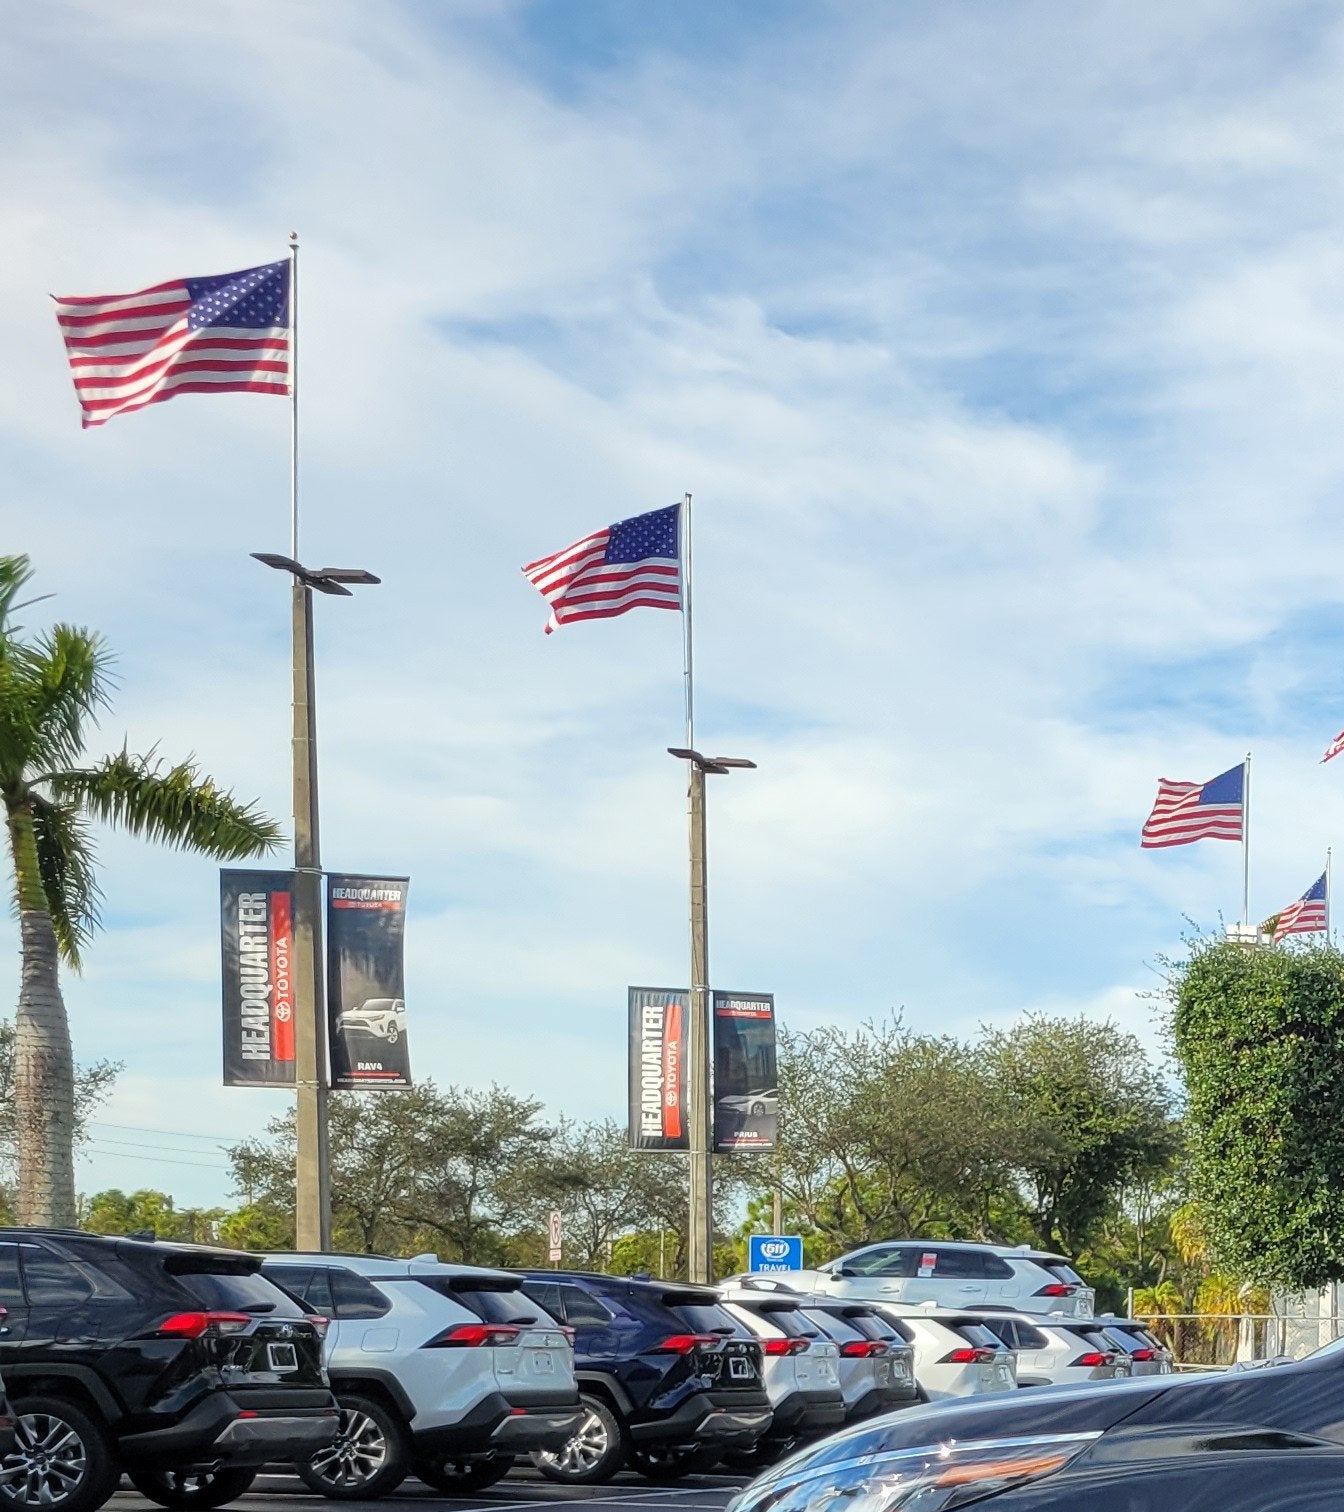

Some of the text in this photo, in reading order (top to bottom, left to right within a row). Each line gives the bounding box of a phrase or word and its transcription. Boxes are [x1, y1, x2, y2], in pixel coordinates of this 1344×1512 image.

[333, 888, 402, 901] HEADQUARTER
[238, 892, 273, 1060] HEADQUARTER
[276, 936, 289, 999] TOYOTA
[357, 1062, 383, 1071] RAV4
[641, 1005, 664, 1137] HEADQUARTER
[667, 1040, 678, 1090] TOYOTA
[766, 1243, 785, 1254] 511
[758, 1263, 791, 1272] TRAVEL
